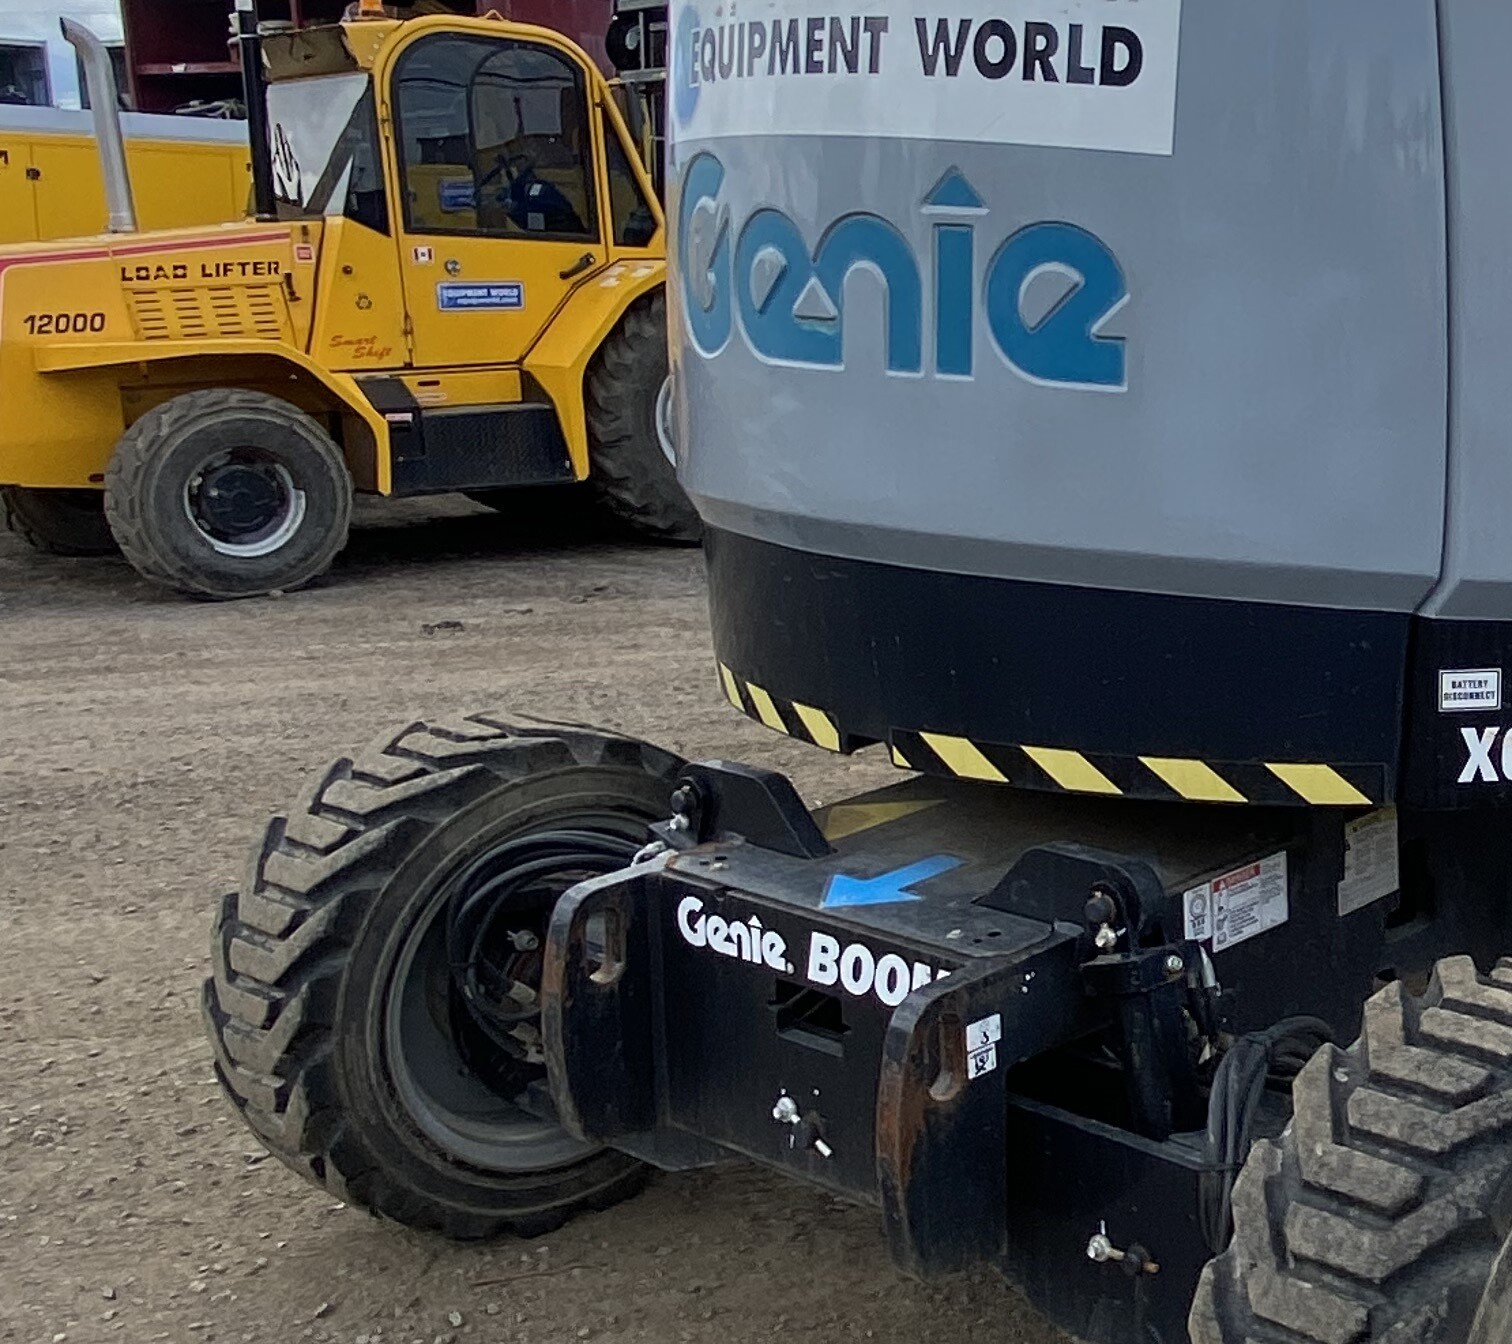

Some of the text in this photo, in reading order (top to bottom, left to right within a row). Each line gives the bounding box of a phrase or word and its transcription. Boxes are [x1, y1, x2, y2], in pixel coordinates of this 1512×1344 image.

[691, 16, 1143, 87] EQUIPMENT WORLD
[120, 261, 281, 282] LOAD LIFTER
[681, 152, 1130, 392] Genie
[24, 313, 105, 335] 12000
[1452, 680, 1488, 689] BATTERY
[677, 896, 788, 973] Genie
